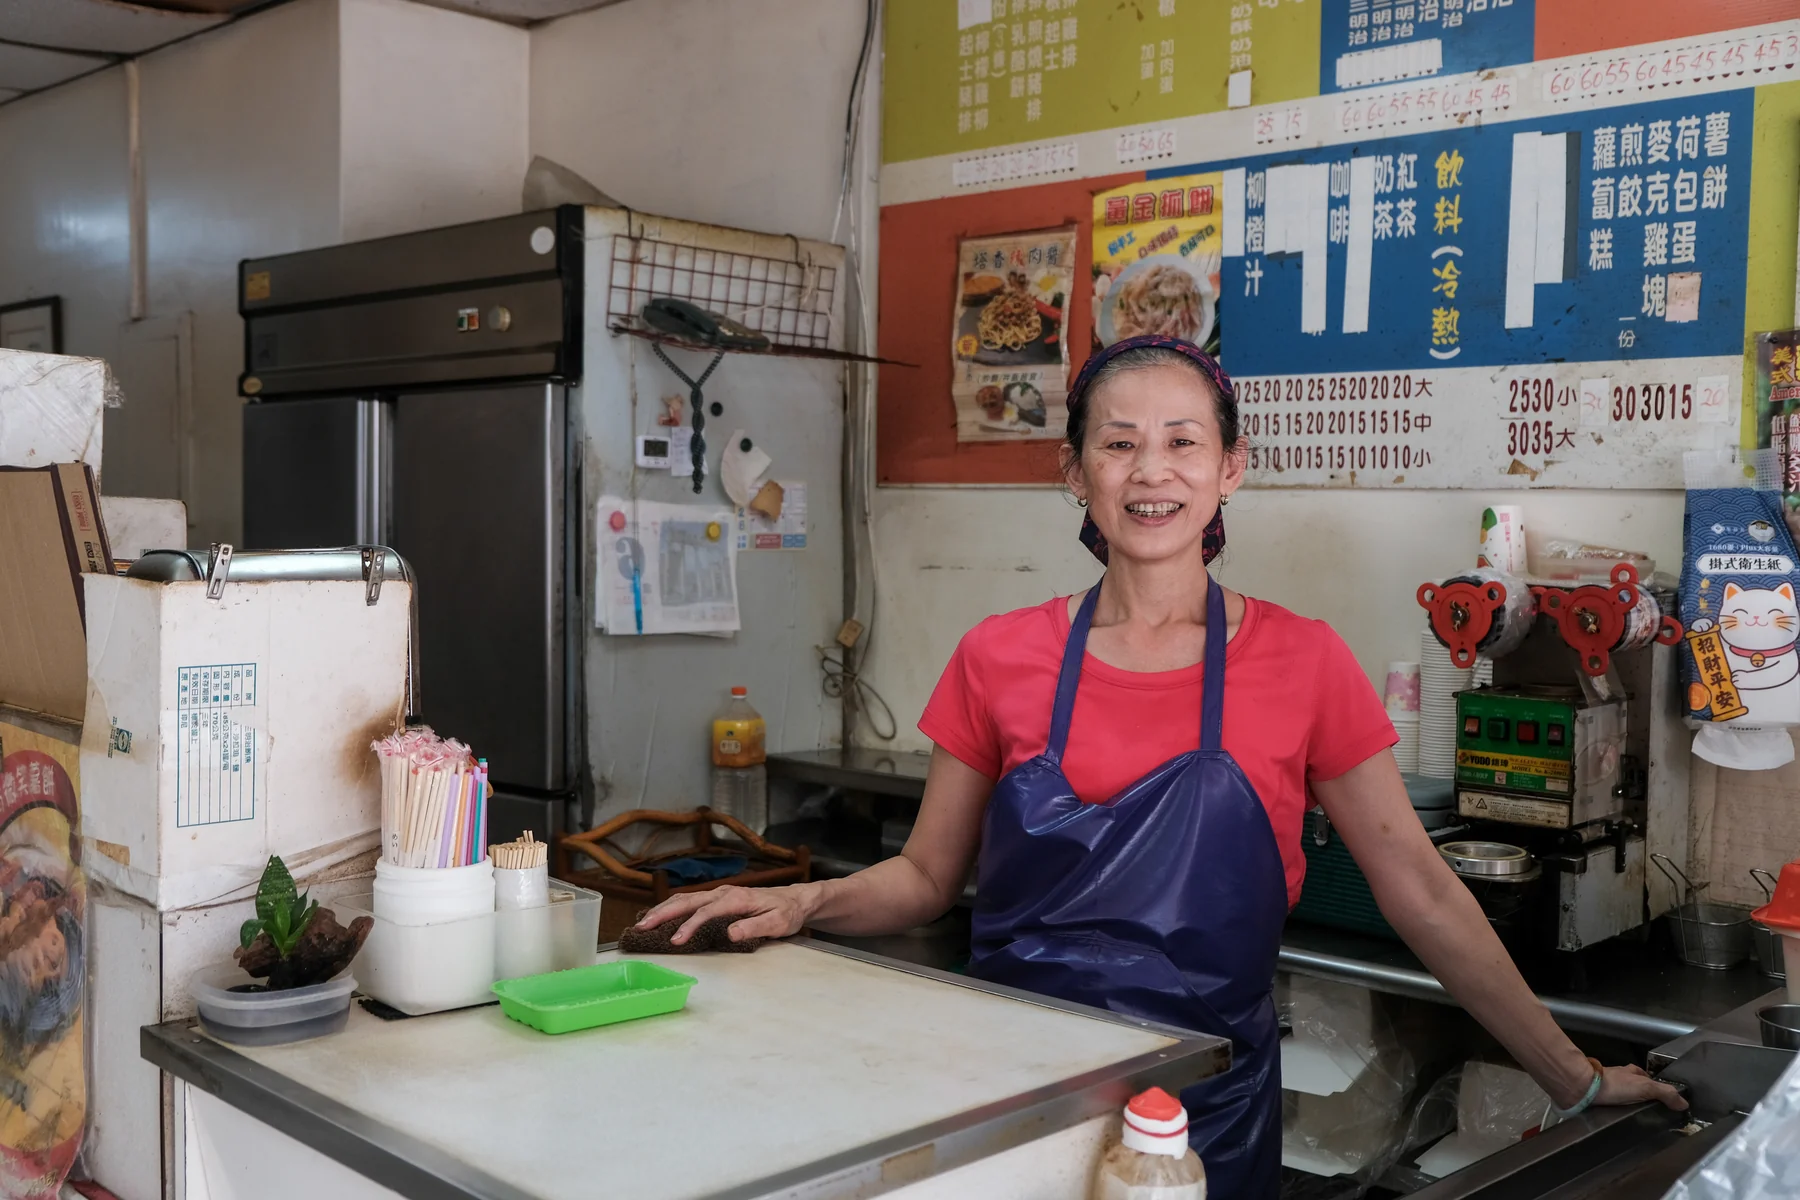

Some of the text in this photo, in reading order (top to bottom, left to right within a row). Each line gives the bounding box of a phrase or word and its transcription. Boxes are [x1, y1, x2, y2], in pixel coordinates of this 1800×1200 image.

[1550, 72, 1575, 95] 60
[1580, 68, 1603, 91] 60
[1605, 61, 1630, 86] 55
[1636, 60, 1657, 81] 60
[1662, 55, 1689, 76] 45
[1690, 50, 1718, 72] 45
[1722, 44, 1749, 66] 45
[1330, 161, 1350, 244] 咖啡
[1374, 155, 1395, 240] 奶茶
[1397, 152, 1418, 238] 紅茶
[1589, 125, 1617, 271] 蘿蔔糕
[1617, 123, 1644, 219] 煎餃
[1671, 114, 1701, 265] 荷包蛋
[1702, 111, 1730, 209] 薯餅
[1105, 185, 1213, 227] 黃金抓餅
[1244, 171, 1265, 297] 柳橙汁
[1641, 120, 1672, 318] 麥克雞塊
[1618, 317, 1636, 348] 一份
[1770, 346, 1793, 385] 美式
[1709, 557, 1782, 571] 掛式衛生紙
[1697, 636, 1735, 710] 招財平安
